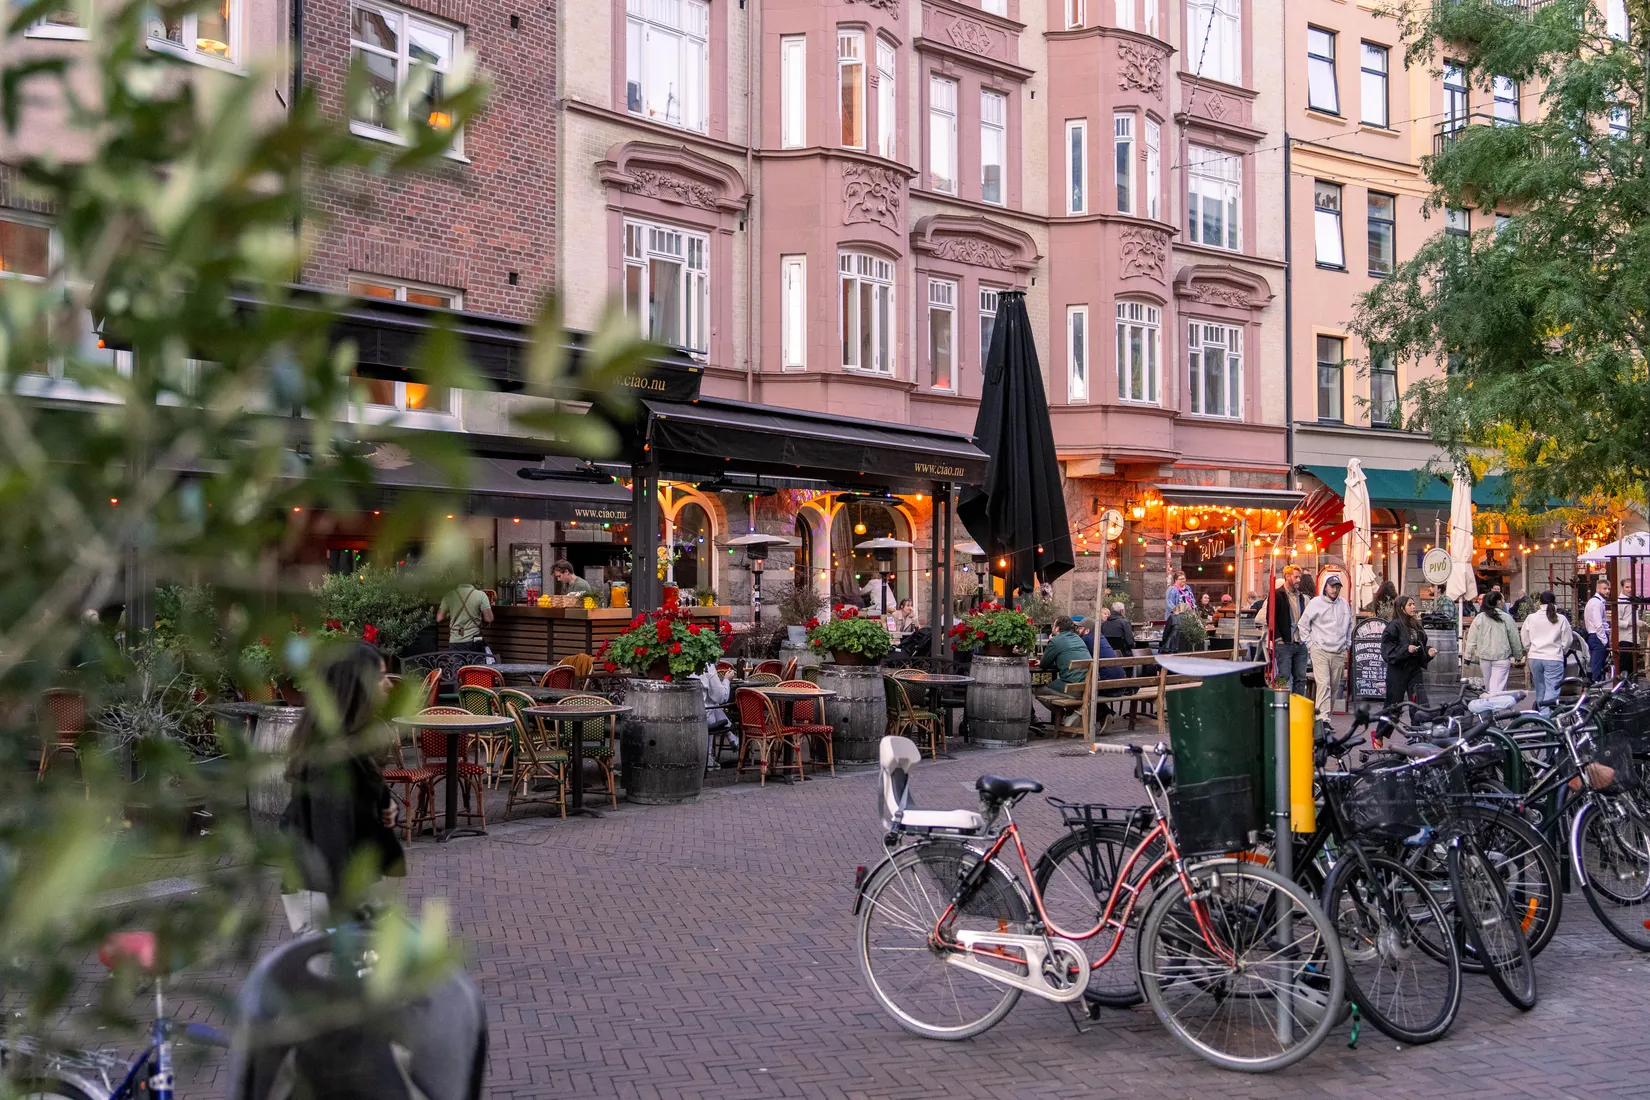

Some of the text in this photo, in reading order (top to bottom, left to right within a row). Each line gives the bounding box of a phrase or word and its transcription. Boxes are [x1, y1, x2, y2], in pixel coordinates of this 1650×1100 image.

[612, 371, 666, 391] w.ciao.nu
[914, 462, 965, 477] www.ciao.nu
[574, 507, 627, 519] www.ciao.nu
